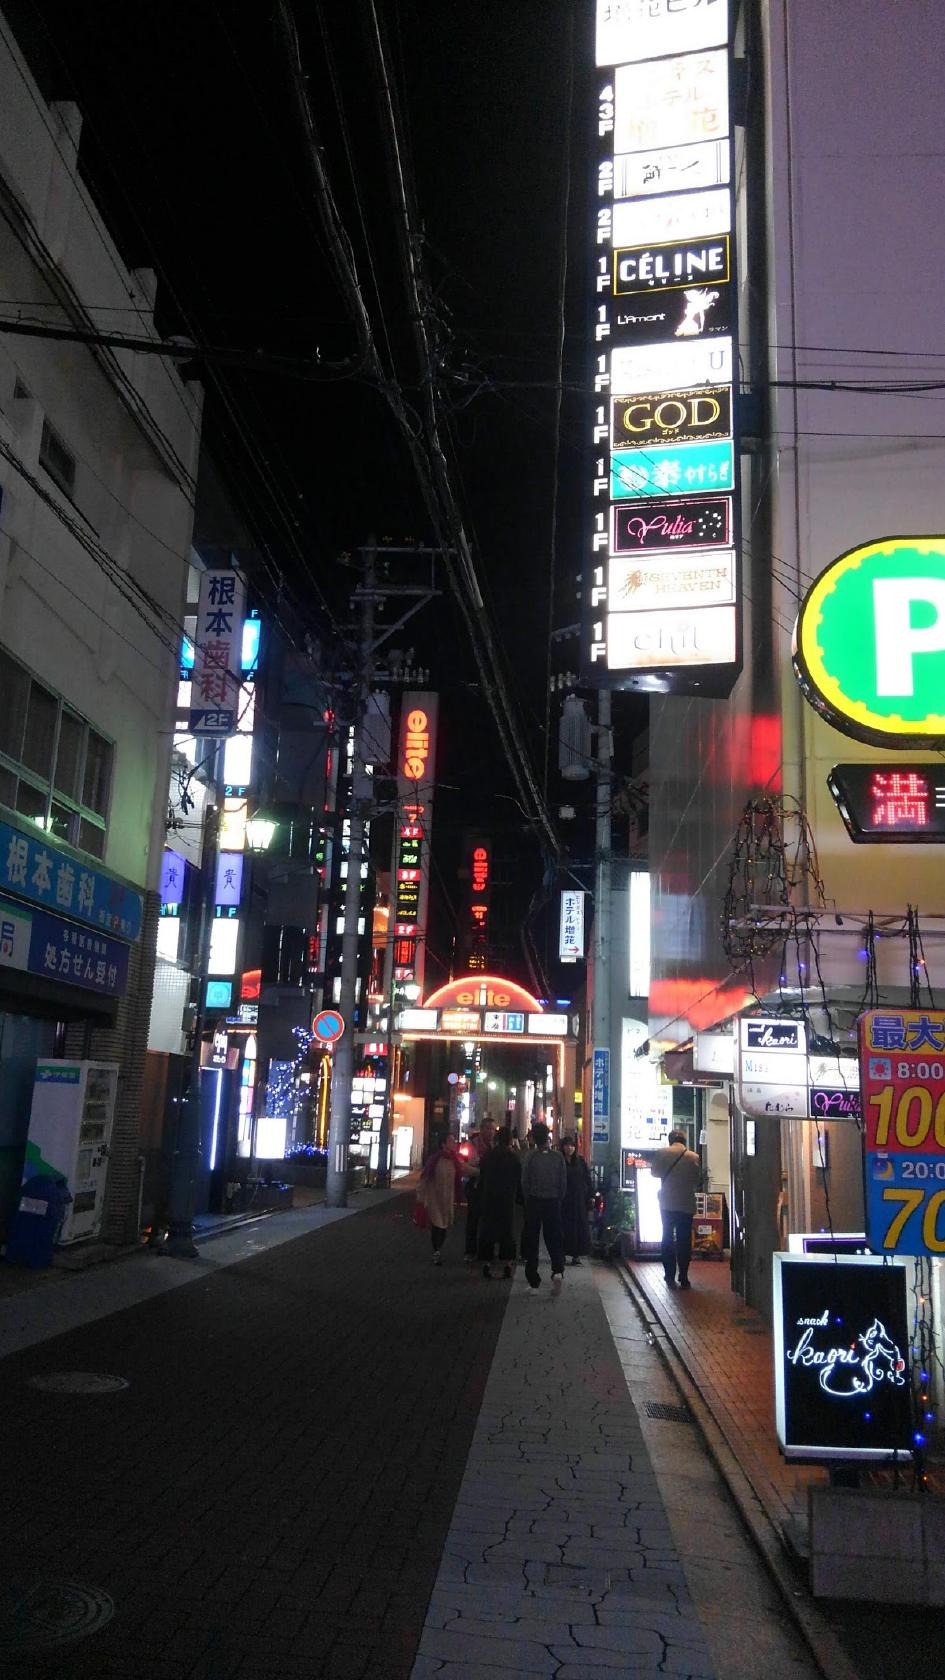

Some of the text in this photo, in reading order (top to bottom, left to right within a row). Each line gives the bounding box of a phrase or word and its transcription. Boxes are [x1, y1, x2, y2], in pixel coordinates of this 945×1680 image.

[597, 160, 614, 196] 2F
[596, 208, 612, 244] 2F
[596, 256, 611, 292] 1F
[619, 247, 724, 282] CÉLINE
[595, 304, 610, 341] 1F
[595, 354, 610, 392] 1F
[593, 406, 609, 444] 1F
[623, 397, 721, 432] GOD
[593, 457, 608, 497] 1F
[593, 512, 608, 552] 1F
[627, 513, 696, 545] Yulia
[591, 565, 607, 607] 1F
[655, 580, 722, 594] HEAVEN
[201, 575, 236, 703] 根本歯科
[590, 621, 606, 662] 1F
[872, 576, 945, 697] P
[206, 712, 230, 726] 2F
[404, 709, 429, 780] elite
[225, 785, 247, 796] 2F
[872, 773, 928, 825] 満
[6, 834, 96, 916] 根本歯科
[223, 867, 237, 890] 貴
[216, 906, 238, 918] 1F
[564, 897, 576, 945] ホテル増花
[43, 941, 119, 988] 処方せん受付
[456, 983, 511, 1007] elite
[897, 1062, 944, 1080] 8:00
[796, 1309, 829, 1326] snack
[786, 1327, 860, 1367] kaori
